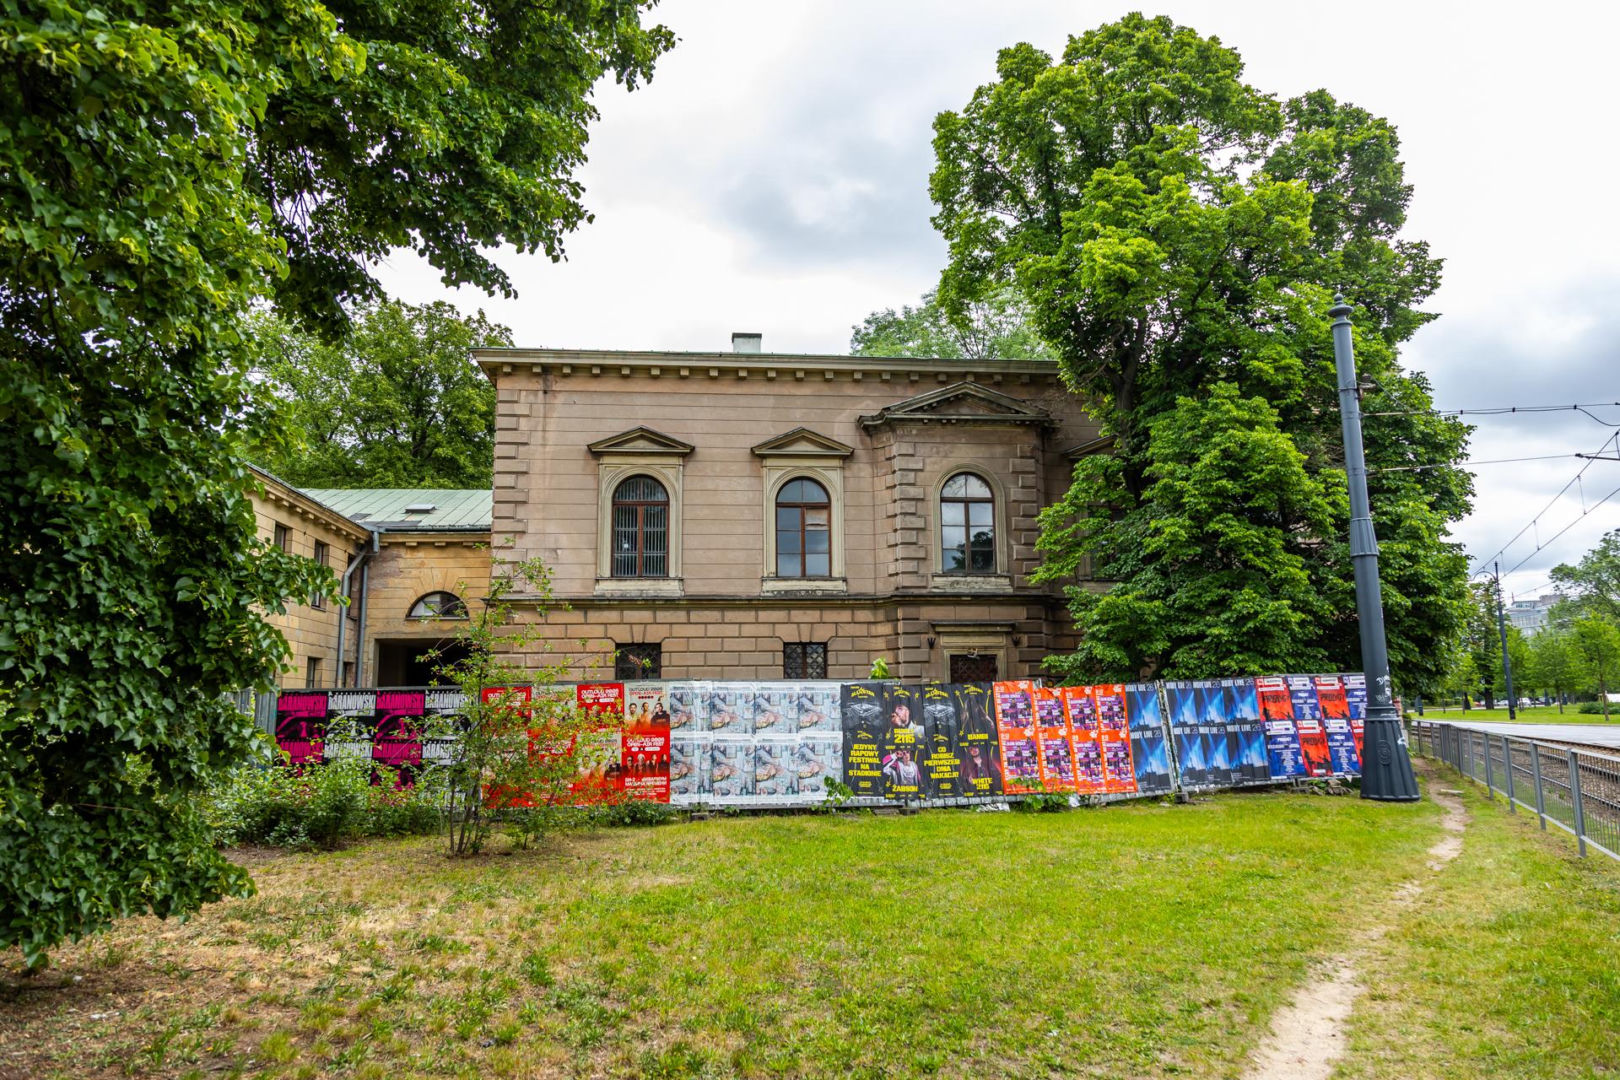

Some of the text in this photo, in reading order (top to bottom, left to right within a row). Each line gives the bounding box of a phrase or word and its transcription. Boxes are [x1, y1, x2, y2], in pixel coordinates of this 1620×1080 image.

[894, 734, 915, 744] 2115
[848, 756, 881, 764] FESTIWAL
[972, 777, 993, 785] WHITE
